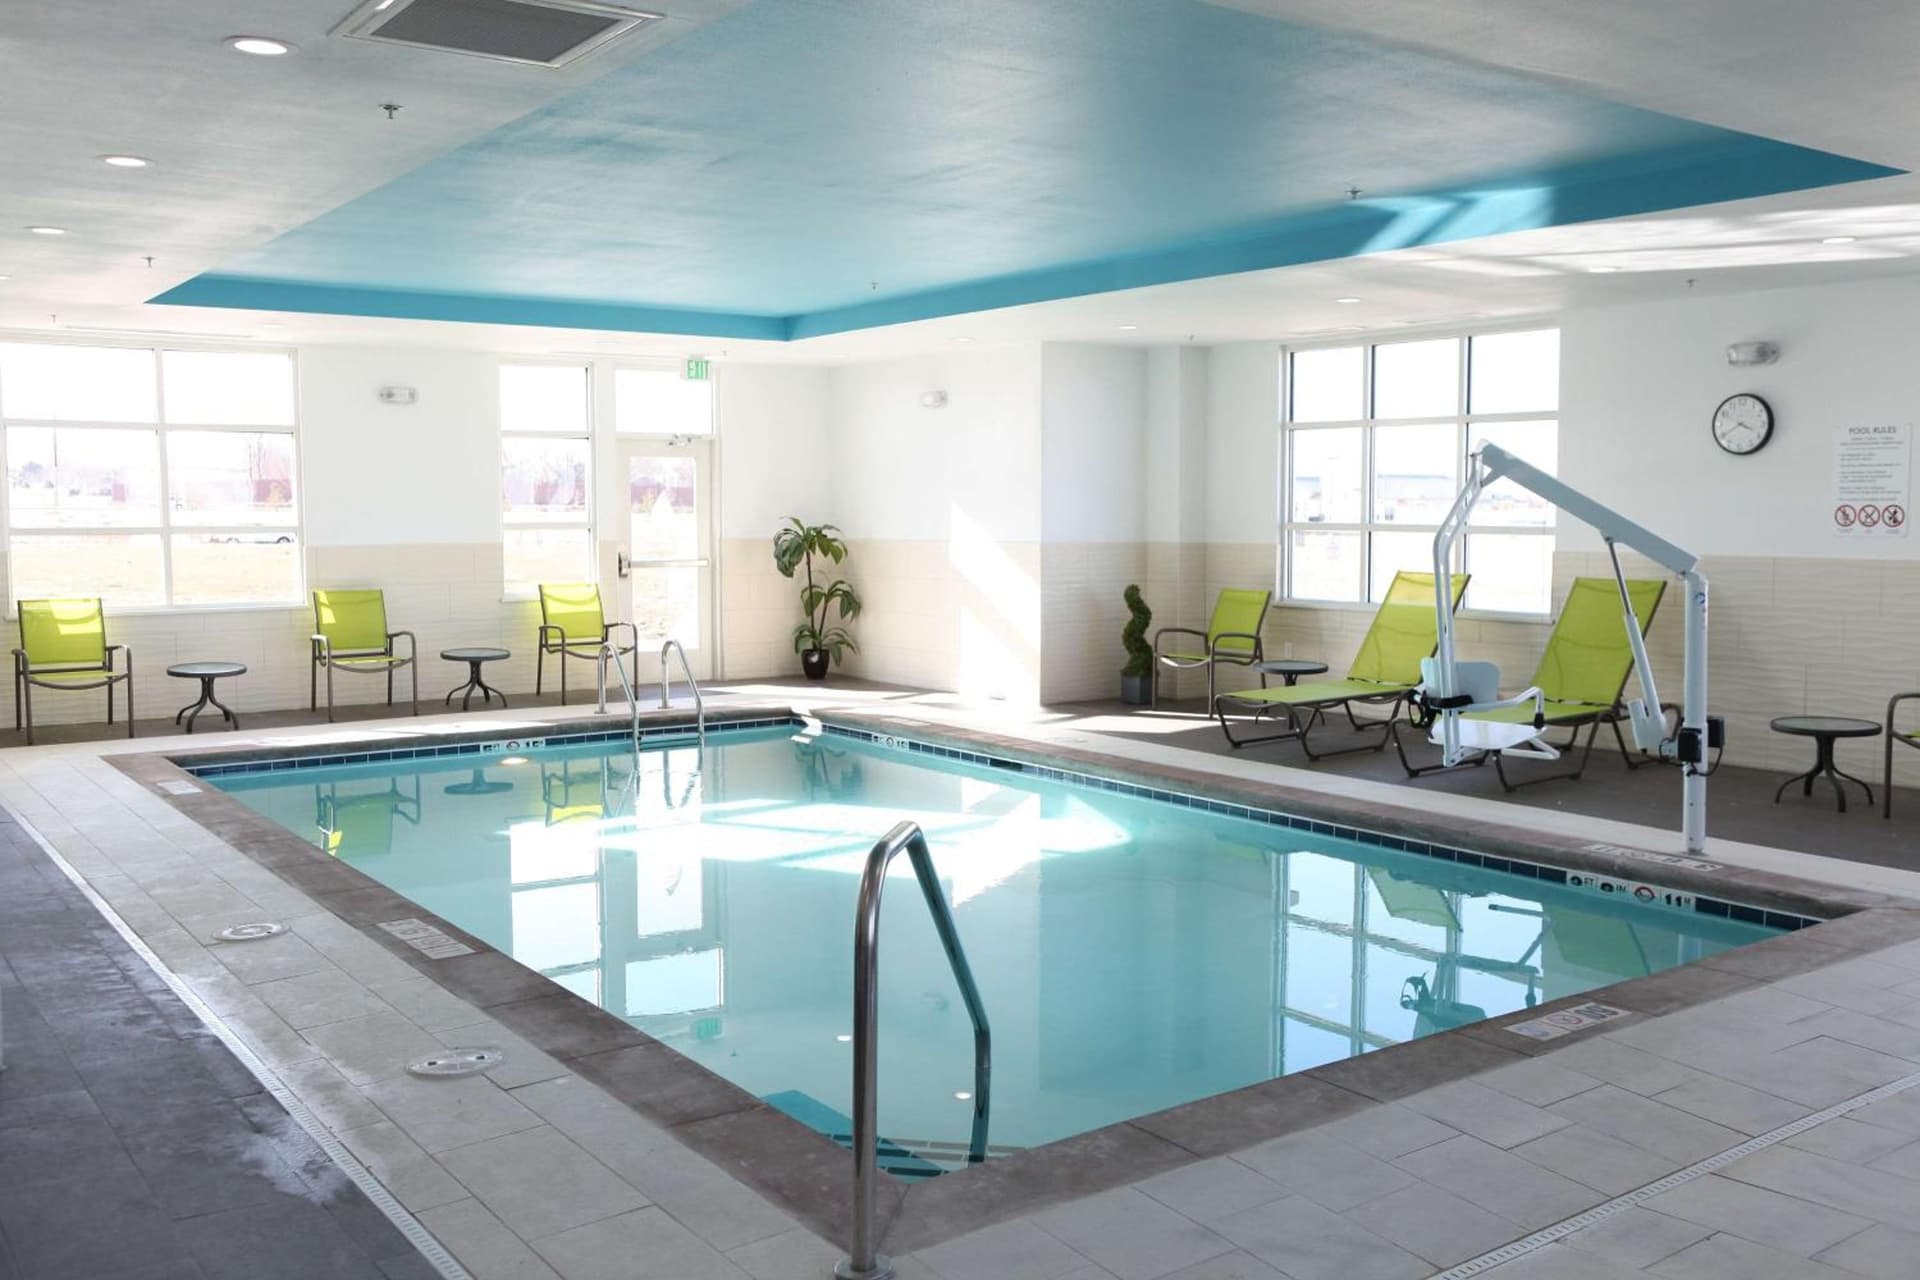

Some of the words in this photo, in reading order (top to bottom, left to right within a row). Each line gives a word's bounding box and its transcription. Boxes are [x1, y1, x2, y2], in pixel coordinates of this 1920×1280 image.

[687, 359, 712, 380] EXIT
[1848, 426, 1871, 435] POOL
[1873, 426, 1897, 434] RULES
